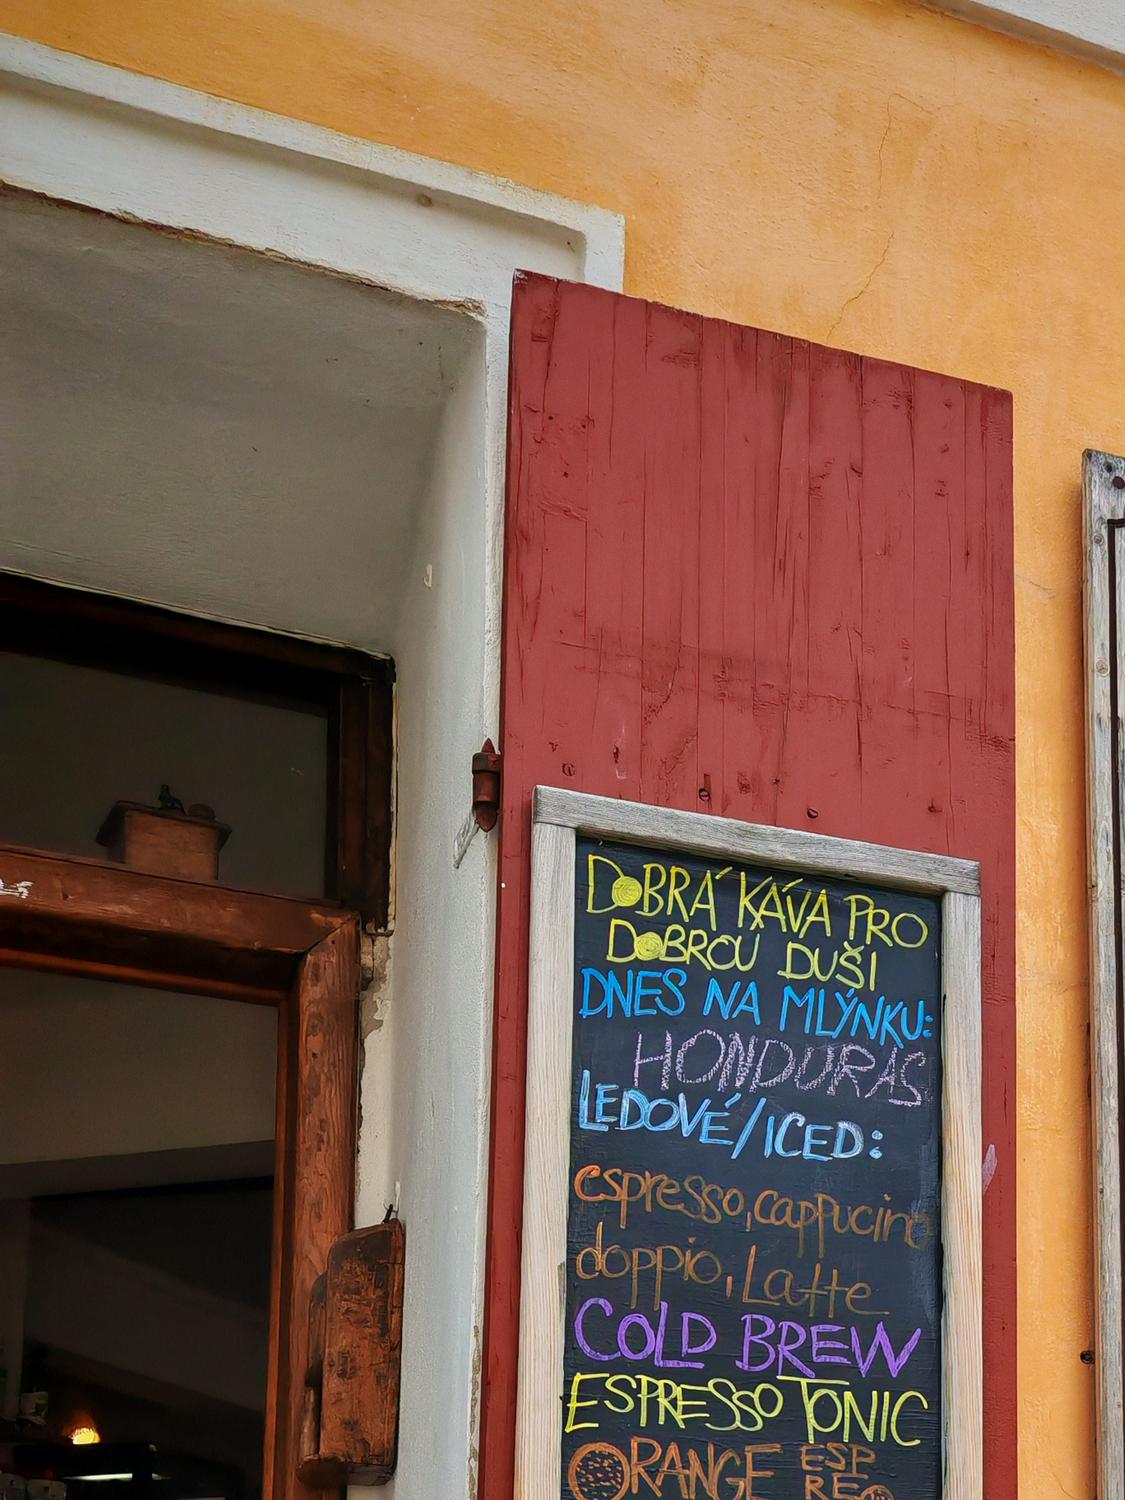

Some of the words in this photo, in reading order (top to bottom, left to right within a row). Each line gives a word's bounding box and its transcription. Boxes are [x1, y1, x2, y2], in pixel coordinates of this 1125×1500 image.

[738, 871, 831, 938] KÁVA
[844, 894, 928, 948] PRO
[579, 967, 688, 1019] DNES
[702, 978, 761, 1026] NA
[777, 940, 877, 991] DUŠI
[632, 1029, 928, 1107] HONDURAS
[574, 1297, 717, 1369] COLD
[735, 1313, 922, 1379] BREW
[565, 1372, 784, 1433] ESPRESSO
[776, 1375, 929, 1447] TONIC
